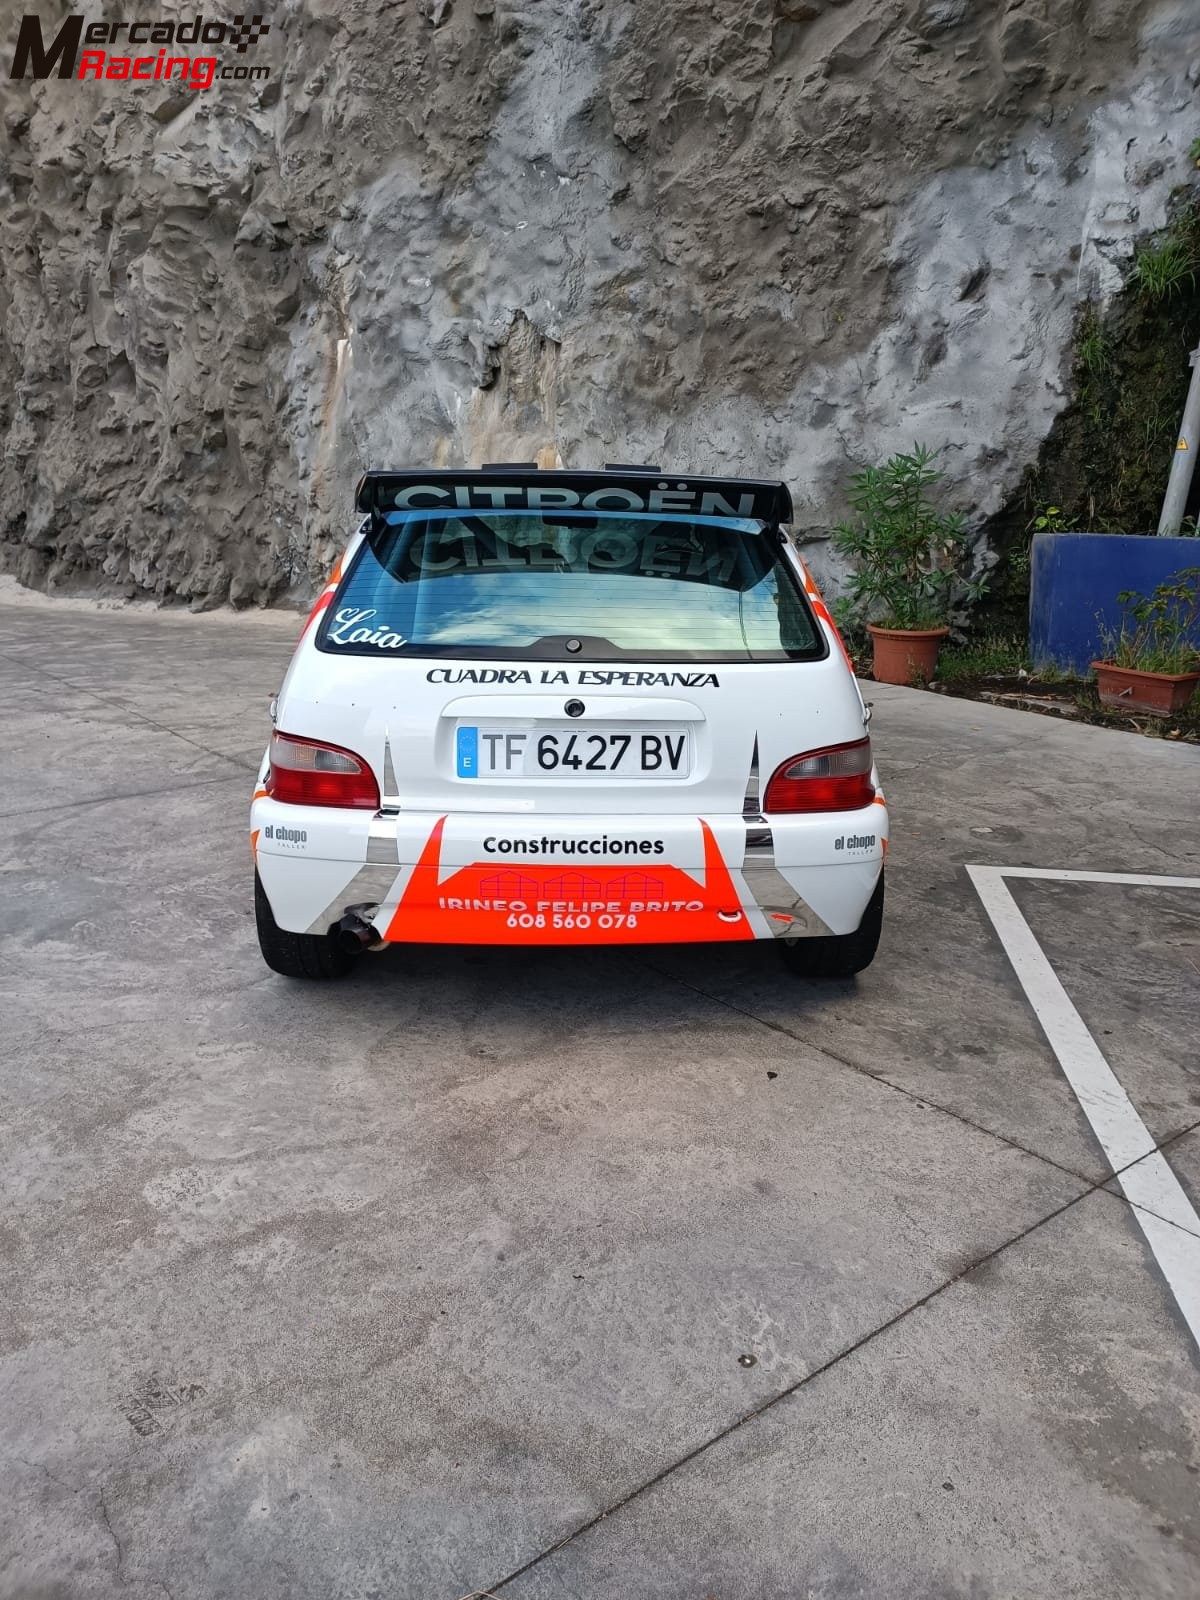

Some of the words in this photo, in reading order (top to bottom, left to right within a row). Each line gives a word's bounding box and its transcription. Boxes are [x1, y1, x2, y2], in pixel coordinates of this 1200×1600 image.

[394, 482, 756, 517] CITROËN
[327, 607, 408, 649] Laia
[425, 668, 532, 684] CUADRA
[540, 669, 570, 685] LA
[577, 670, 721, 688] ESPERANZA
[462, 757, 472, 768] E
[482, 734, 527, 770] TF
[537, 734, 632, 770] 6427
[641, 735, 686, 771] BV
[265, 825, 274, 839] el
[275, 826, 307, 843] chopo
[835, 836, 845, 849] el
[847, 835, 875, 849] chopo
[483, 835, 665, 855] Construcciones
[438, 897, 527, 912] IRINEO
[537, 900, 621, 913] FELIPE
[629, 900, 704, 913] BRITO
[506, 913, 546, 929] 608
[552, 914, 591, 929] 560
[598, 914, 638, 929] 078
